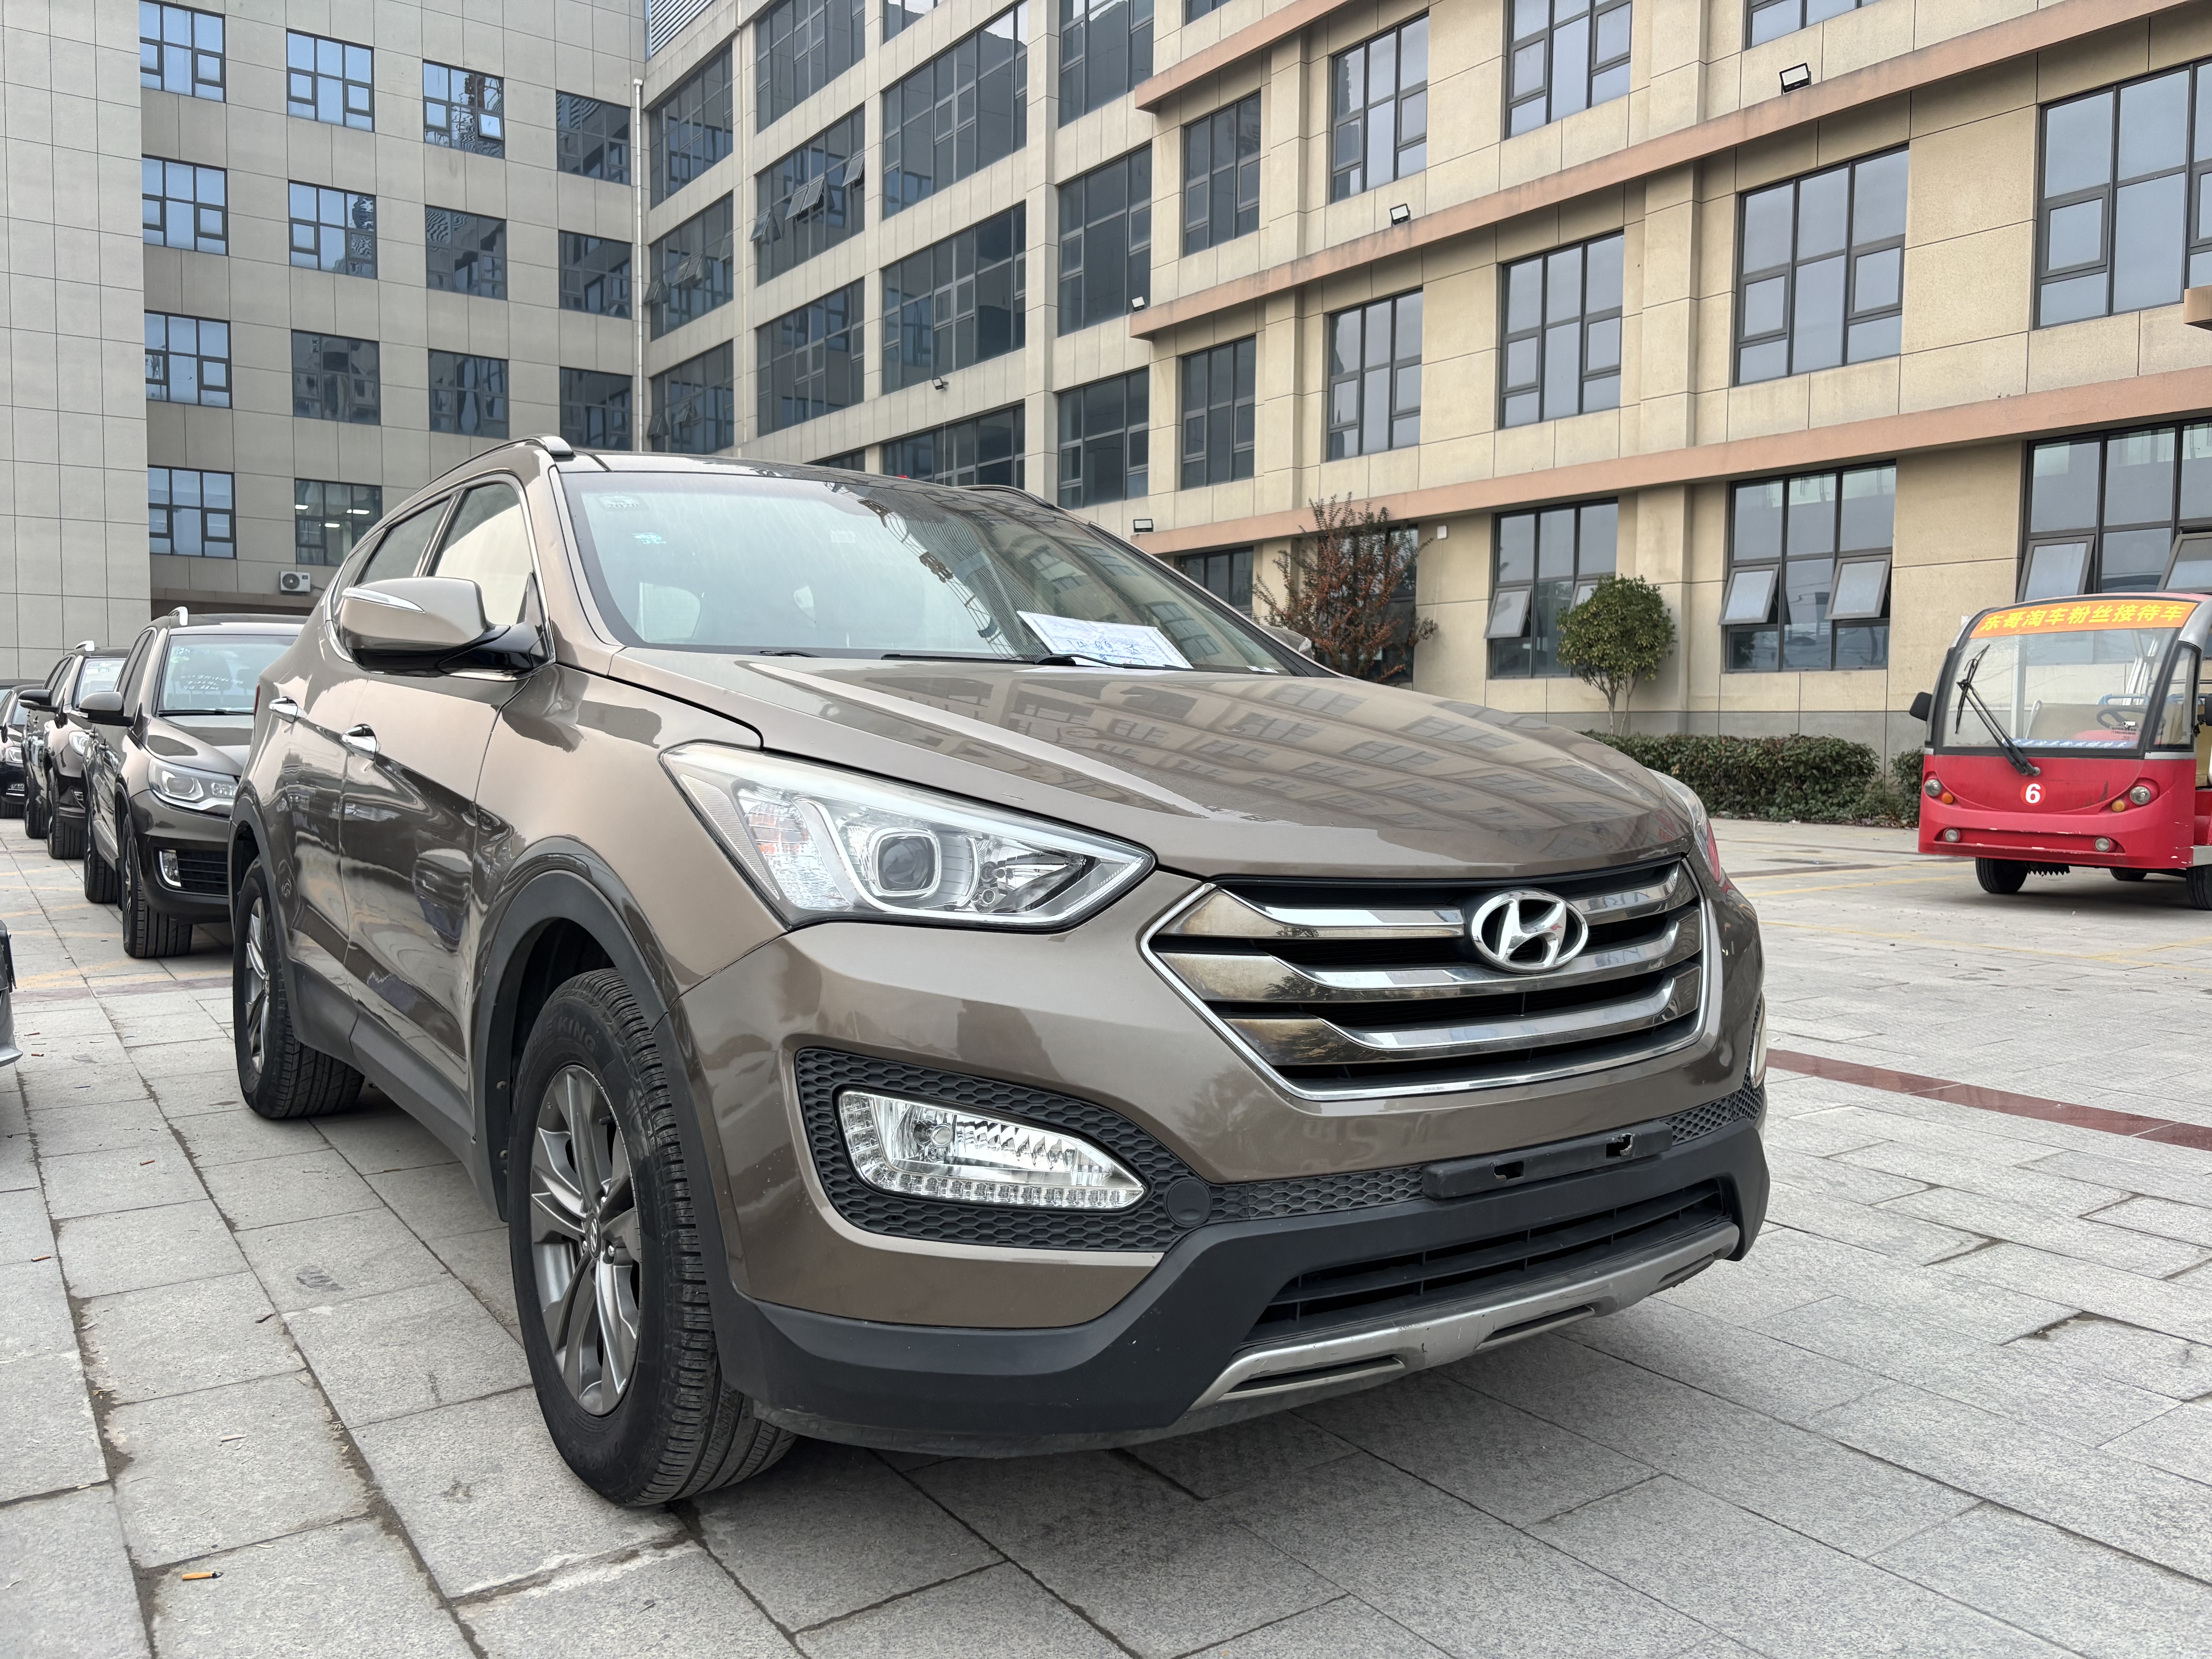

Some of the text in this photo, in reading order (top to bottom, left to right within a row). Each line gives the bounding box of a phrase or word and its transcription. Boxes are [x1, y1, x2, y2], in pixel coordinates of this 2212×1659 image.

[1980, 605, 2186, 631] 东哥淘车粉丝接待车
[2025, 783, 2041, 804] 6
[558, 1016, 596, 1053] KING
